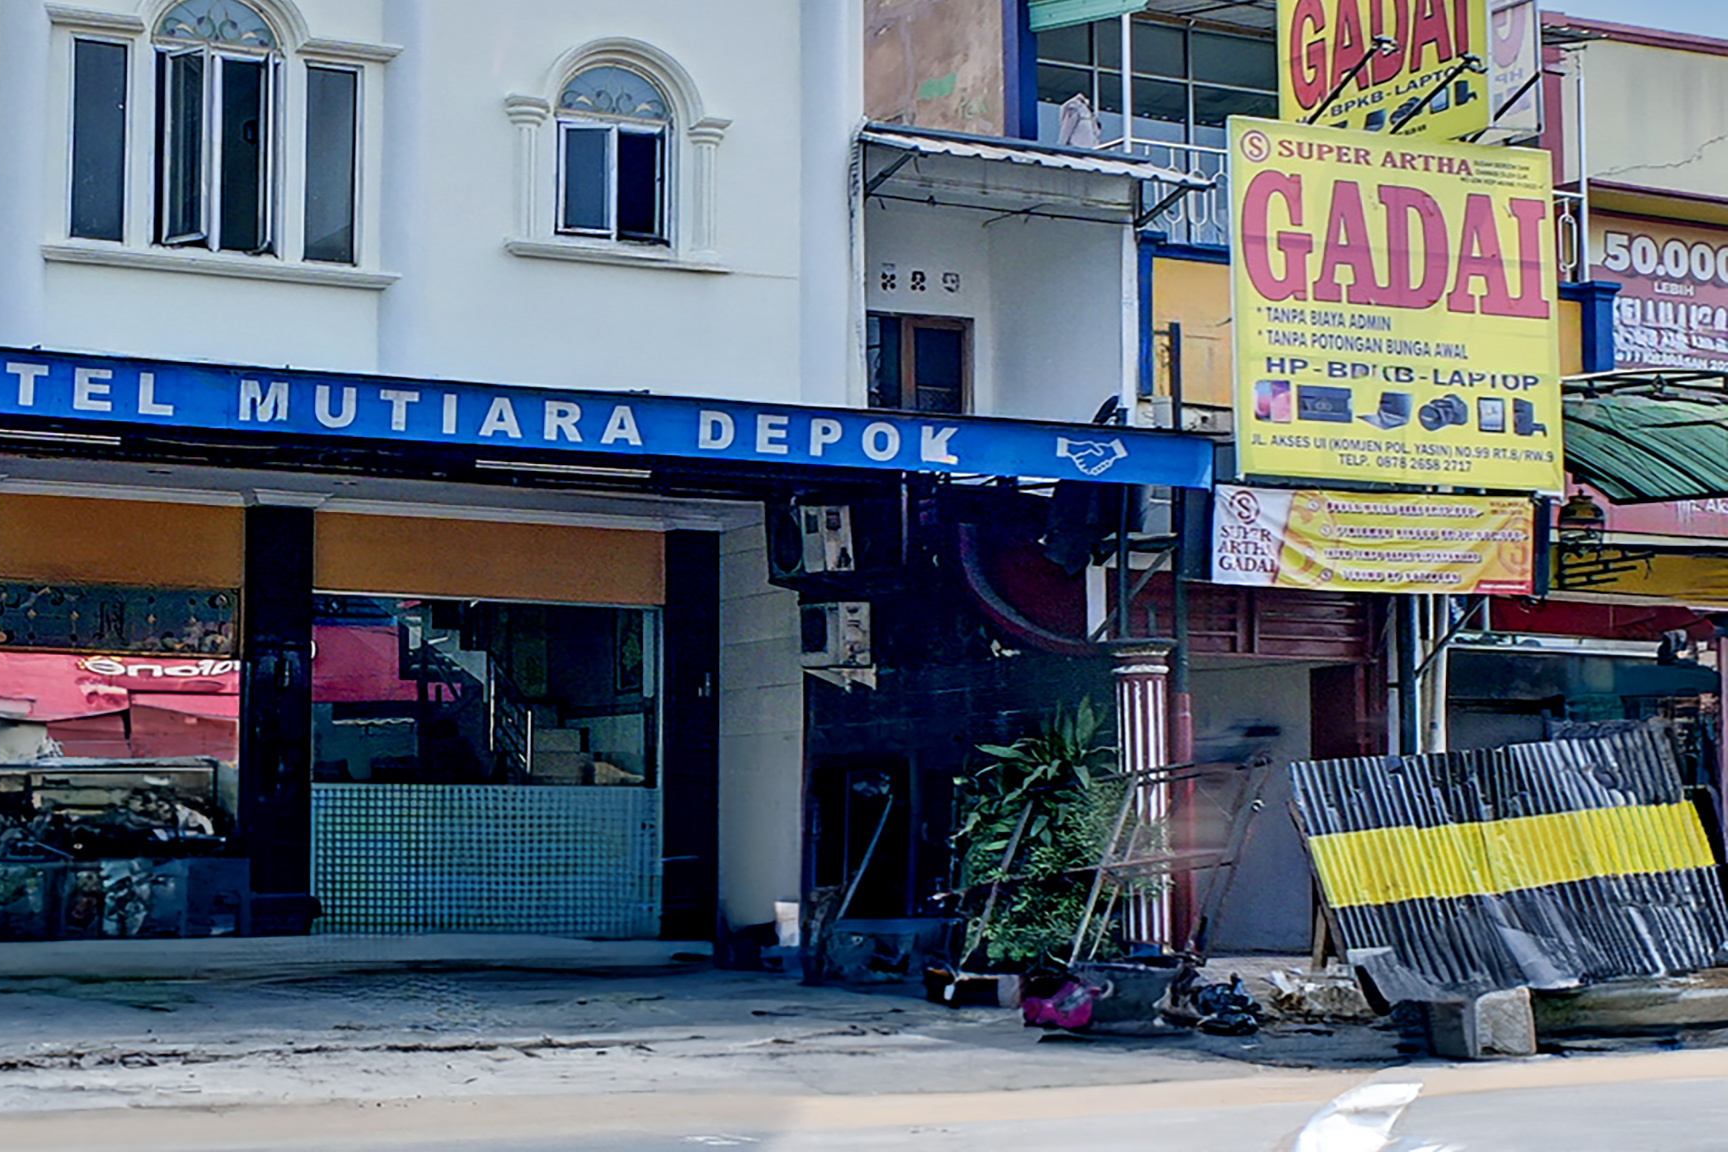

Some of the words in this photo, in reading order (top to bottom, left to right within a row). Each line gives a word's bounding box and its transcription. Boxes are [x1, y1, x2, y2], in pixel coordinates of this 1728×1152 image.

[1278, 139, 1372, 167] SUPER
[1381, 150, 1473, 177] ARTHA
[1241, 169, 1550, 319] GADAI
[1267, 306, 1308, 325] TANPA
[1311, 311, 1346, 329] BIAYA
[1349, 314, 1391, 331] ADMIN
[1267, 329, 1308, 348] TANPA
[1311, 333, 1382, 354] POTONGAN
[1386, 338, 1432, 357] BUNGA
[1434, 342, 1469, 360] AWAL
[238, 378, 643, 446] MUTIARA
[698, 410, 959, 465] DEPOK
[1271, 435, 1311, 449] AKSES
[1339, 453, 1370, 467] TELP.
